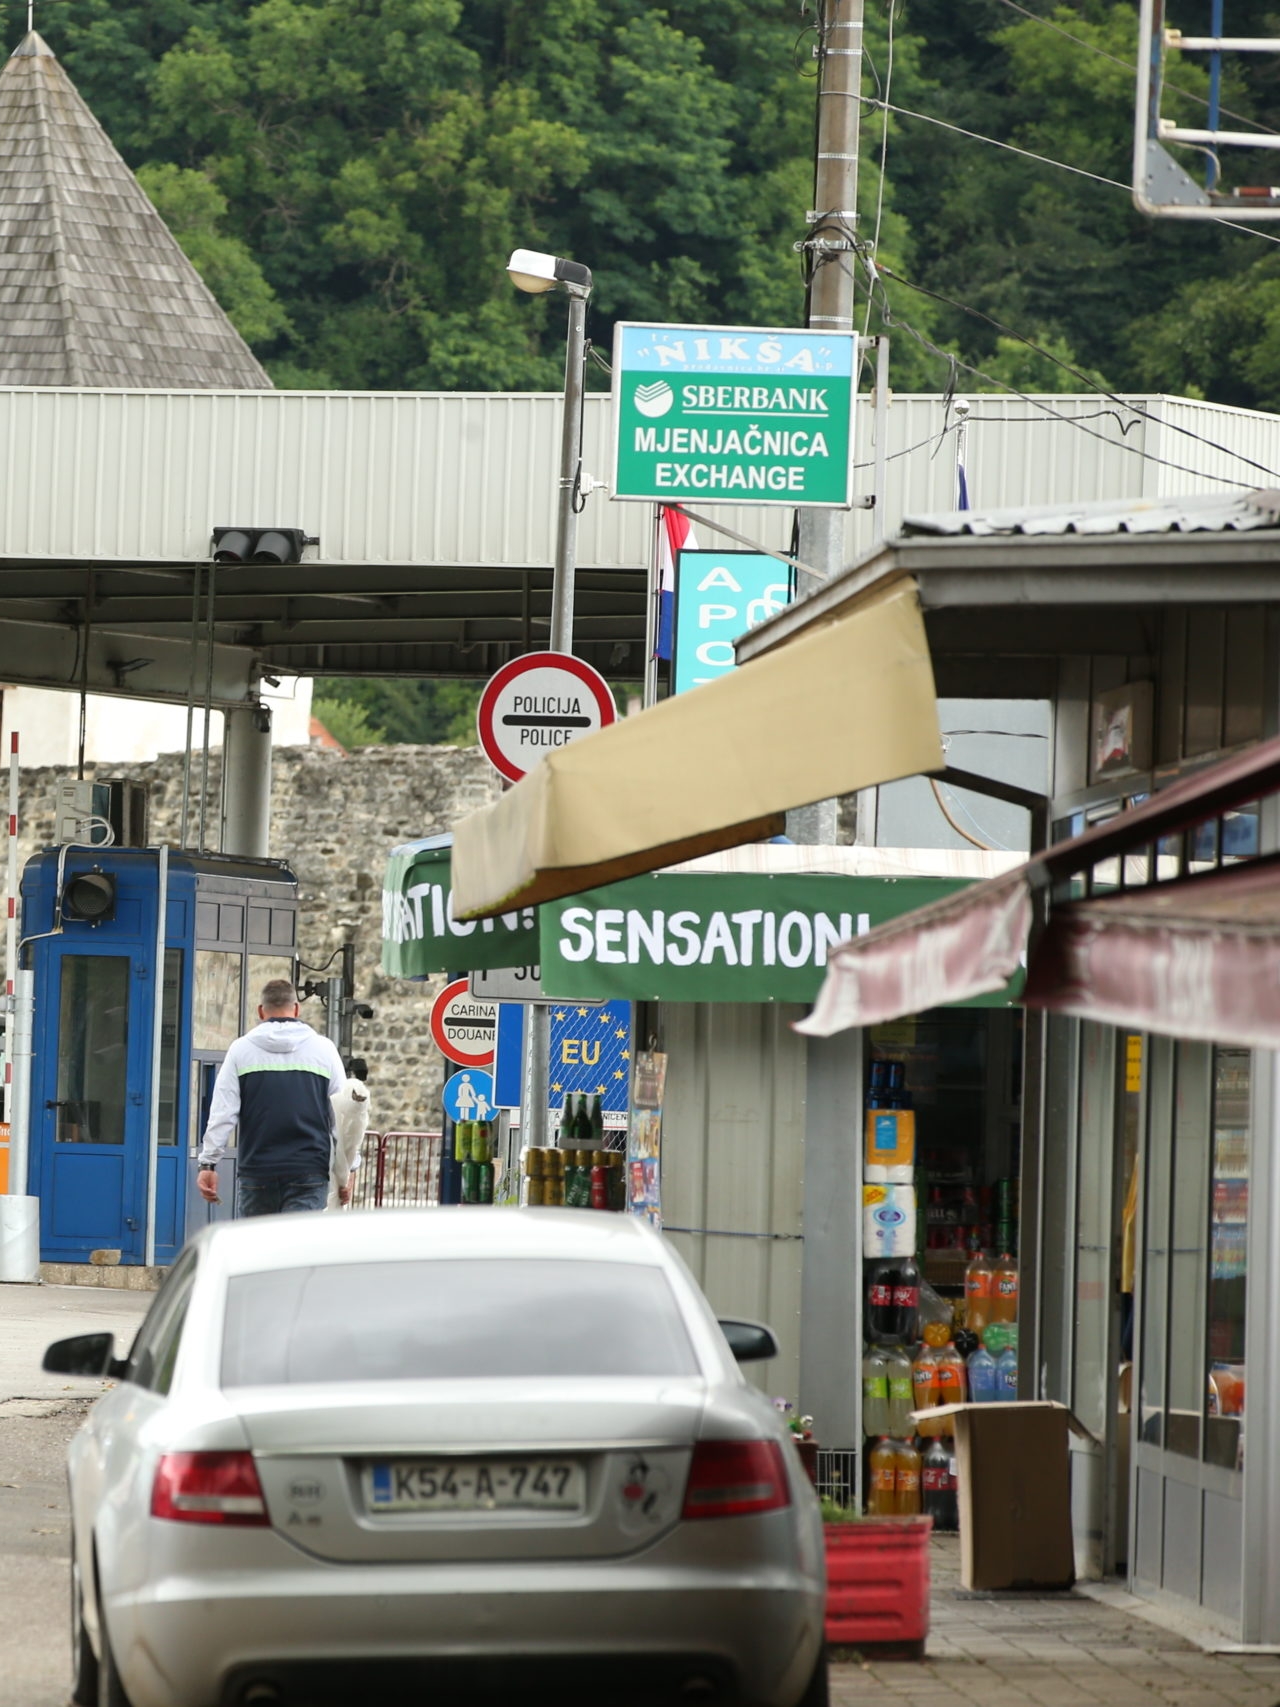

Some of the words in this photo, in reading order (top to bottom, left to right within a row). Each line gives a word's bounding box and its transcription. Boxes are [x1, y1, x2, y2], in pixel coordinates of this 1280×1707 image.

[682, 384, 829, 411] SBERBANK
[634, 423, 829, 457] MJENJAČNICA
[655, 462, 805, 491] EXCHANGE
[513, 695, 581, 715] POLICIJA
[451, 1003, 496, 1017] CARINA
[561, 1039, 602, 1065] EU
[395, 1465, 571, 1500] K54-A-747
